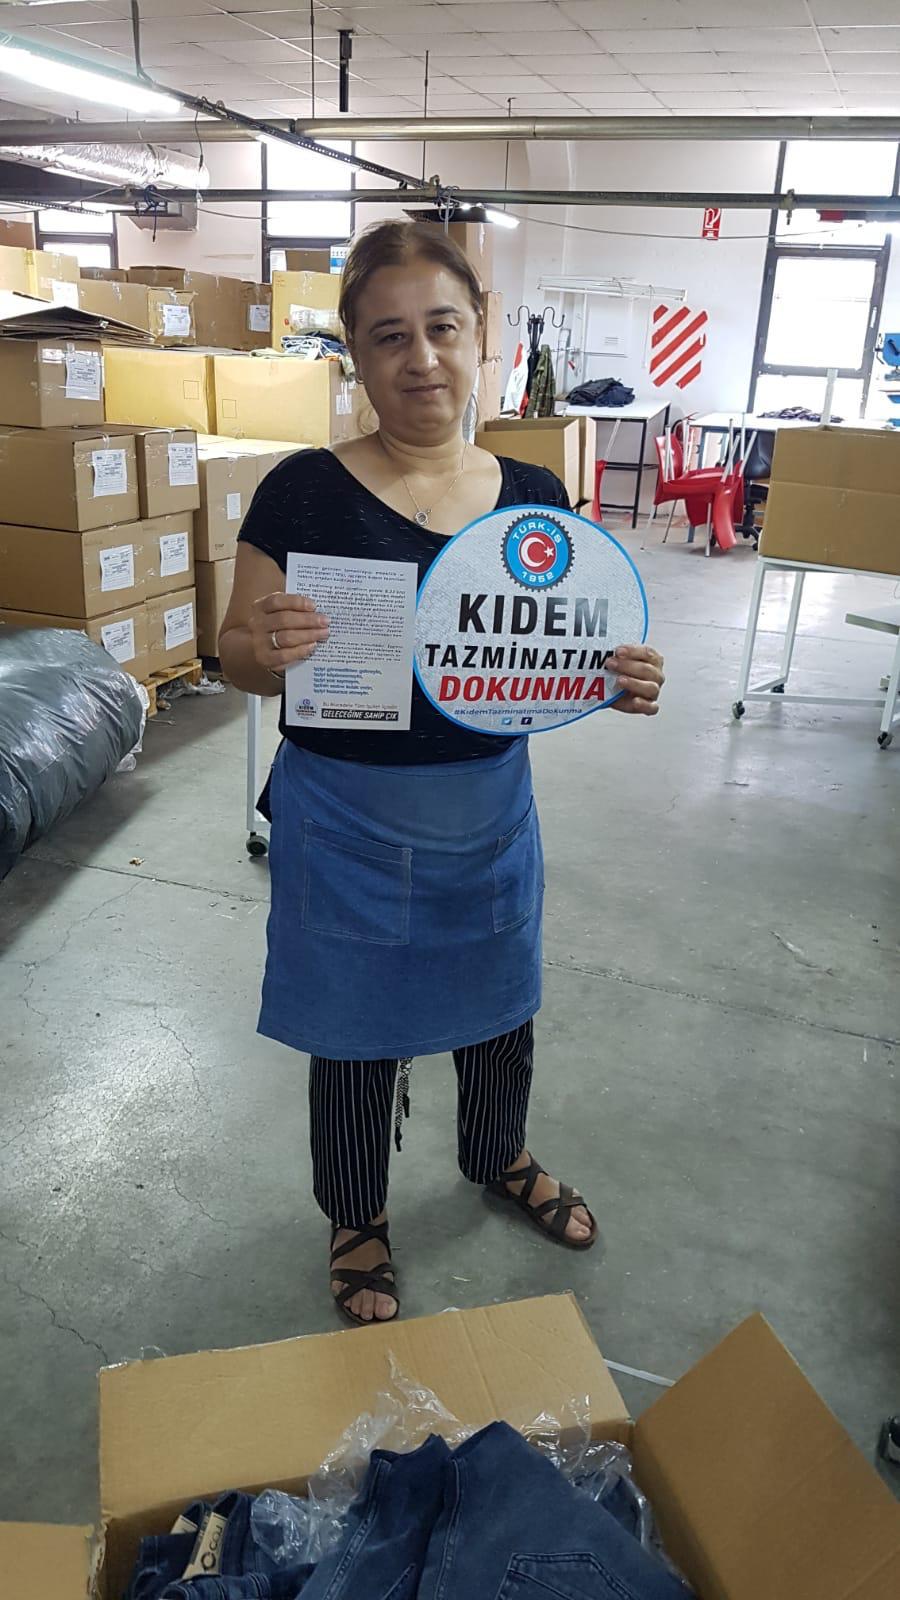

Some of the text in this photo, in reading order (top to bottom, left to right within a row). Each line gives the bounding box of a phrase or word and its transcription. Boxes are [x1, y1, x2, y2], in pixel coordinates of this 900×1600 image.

[521, 571, 555, 583] 1952
[458, 593, 609, 638] KIDEM
[424, 641, 617, 671] TAZMİNATIM
[438, 675, 606, 702] DOKUNMA
[364, 711, 385, 719] SAHİP
